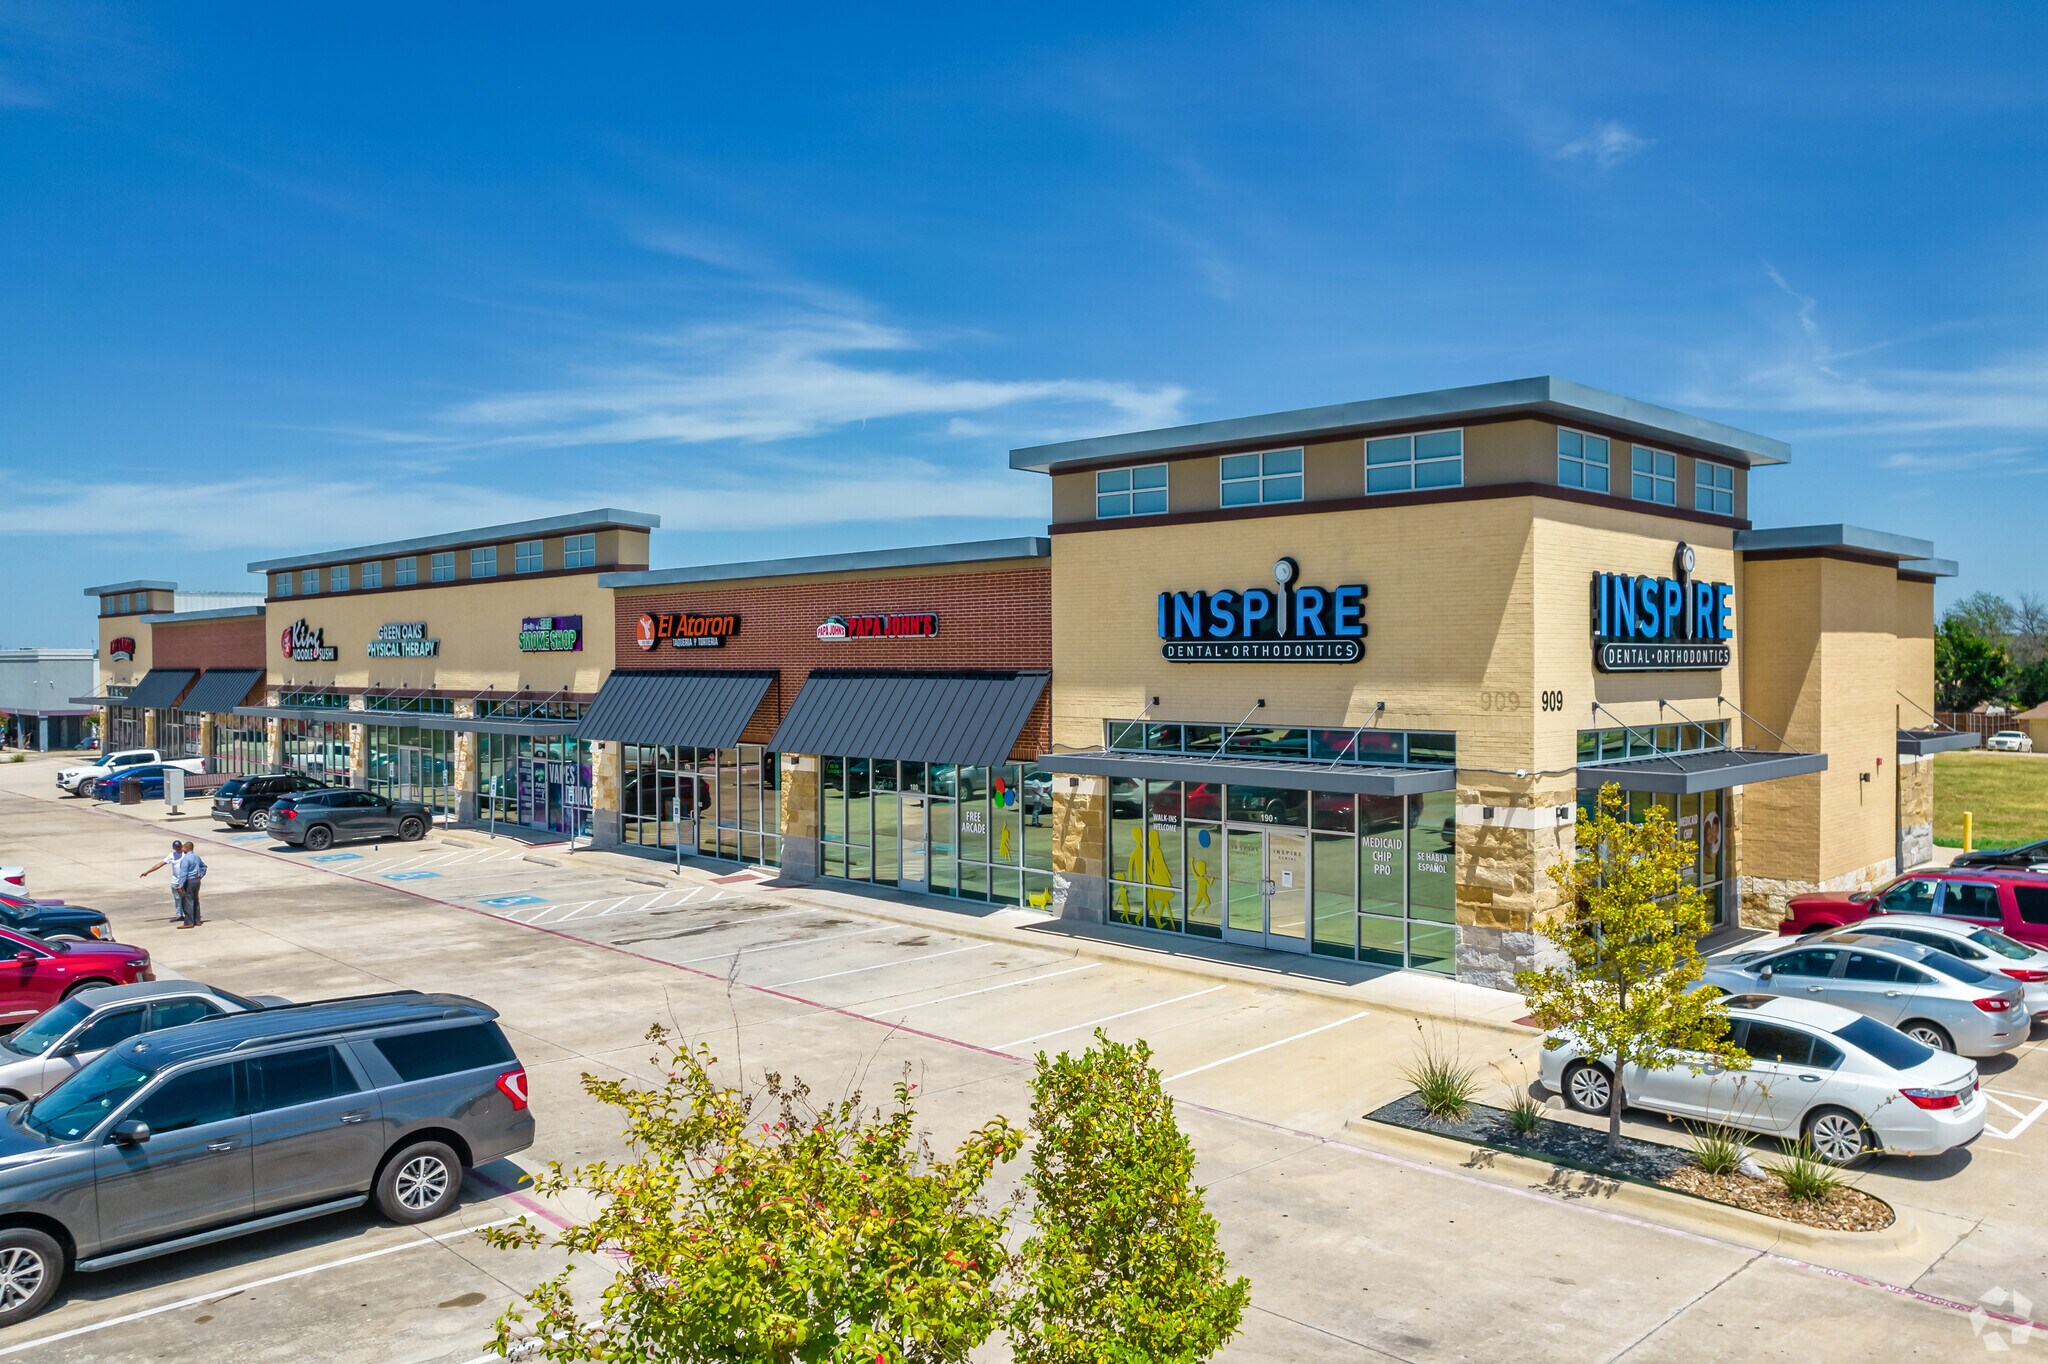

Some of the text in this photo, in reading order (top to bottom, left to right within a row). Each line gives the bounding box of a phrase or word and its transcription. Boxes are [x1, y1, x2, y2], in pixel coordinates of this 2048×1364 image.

[1158, 560, 1364, 638] INSPIRE
[1600, 546, 1733, 640] INSPIRE
[378, 623, 422, 640] GREEN OAKS
[658, 614, 734, 637] El Atoron
[849, 615, 932, 636] PAPA JOHN'S
[292, 620, 320, 648] King
[518, 629, 577, 652] SMOKE SHOP
[293, 648, 313, 661] NOODLE
[319, 648, 335, 660] SUSHI
[367, 641, 435, 657] PHYSICAL THERAPY
[1480, 690, 1521, 712] 909
[1541, 690, 1563, 712] 909
[966, 811, 981, 822] FREE
[1153, 813, 1177, 823] WALK-INS
[1261, 814, 1273, 822] 190
[961, 822, 986, 834] ARCADE
[1153, 822, 1177, 832] WELCOME
[1362, 837, 1402, 849] MEDICAID
[1273, 849, 1302, 857] INSPIRE
[1373, 850, 1392, 862] CHIP
[1417, 851, 1448, 863] SE HABLA
[1374, 863, 1391, 875] PPO
[1418, 862, 1447, 874] ESPAÑOL
